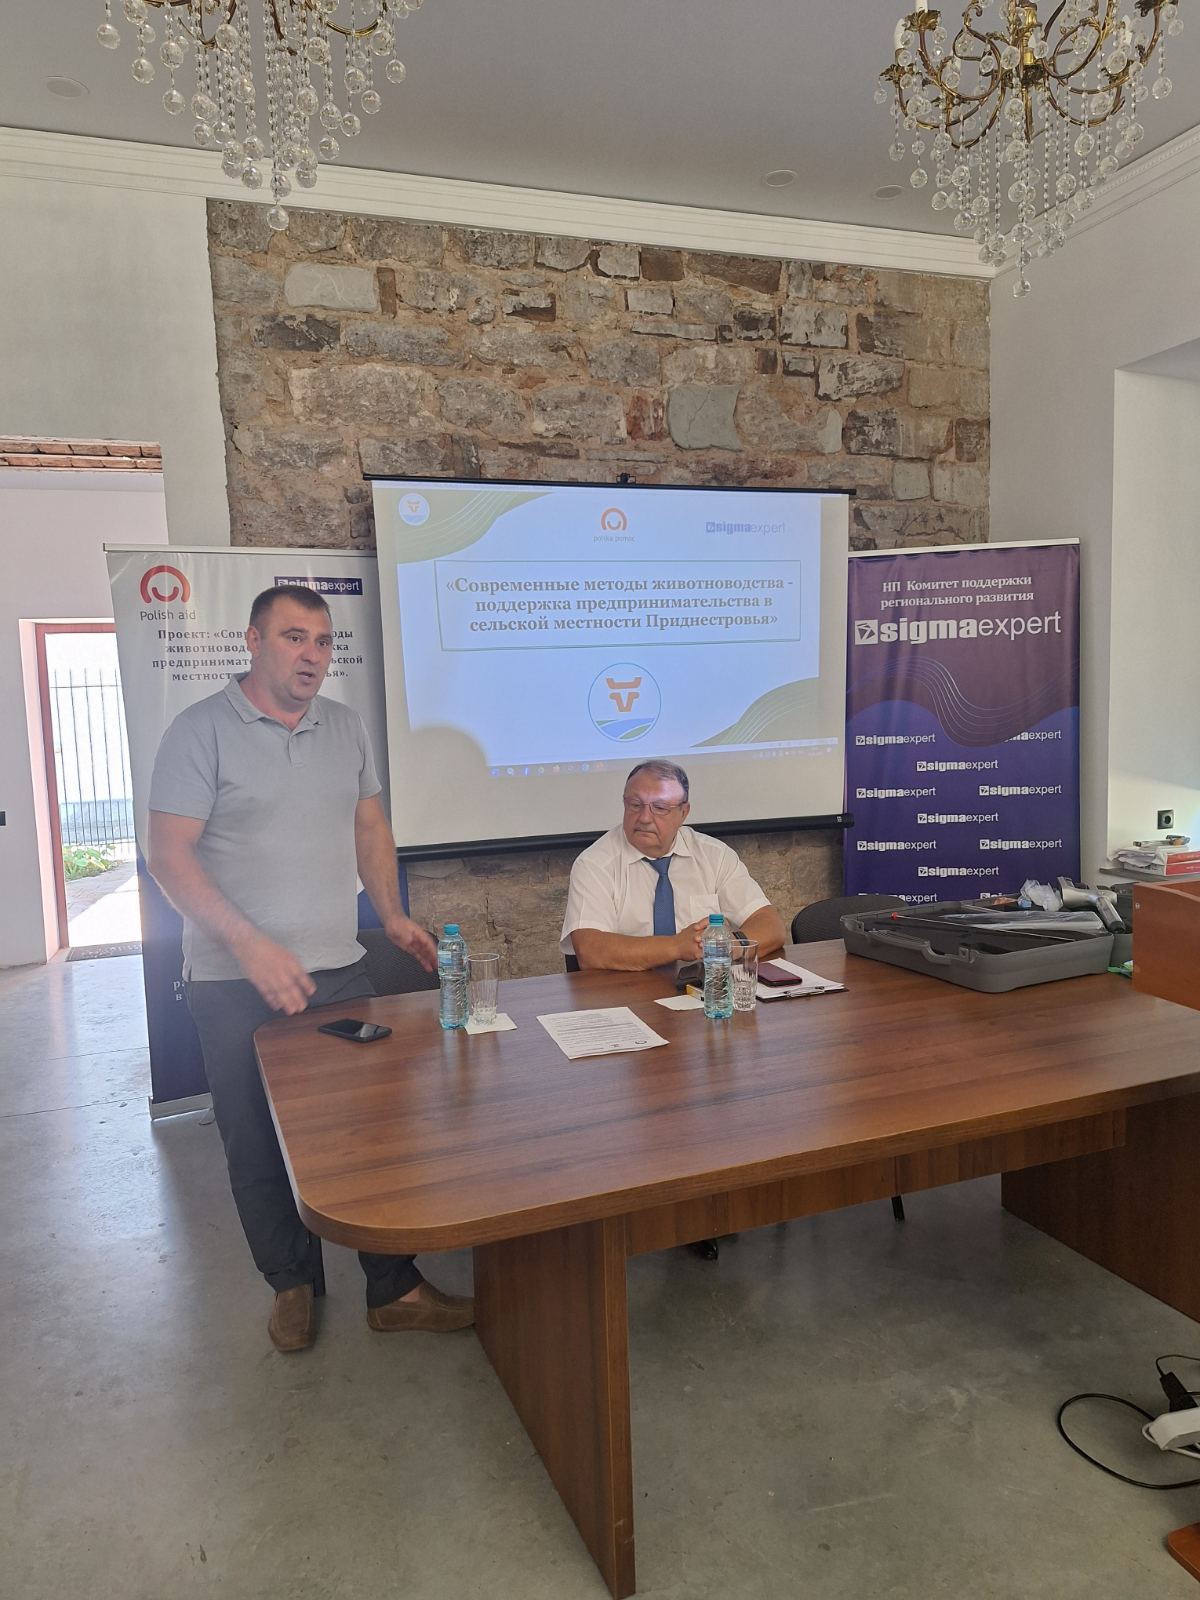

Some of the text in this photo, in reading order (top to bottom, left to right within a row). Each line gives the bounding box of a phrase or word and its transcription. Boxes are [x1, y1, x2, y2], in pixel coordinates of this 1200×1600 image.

[716, 521, 786, 536] sigmaexpert
[446, 577, 580, 595] «Современные
[584, 580, 648, 592] методы
[652, 578, 784, 591] животноводства
[882, 576, 1032, 592] НП Комитет поддержки
[475, 597, 773, 615] поддержка предпринимательства в
[880, 592, 1034, 610] регионального развития
[140, 609, 196, 622] Polish aid
[469, 614, 778, 632] сельской местности Приднестровья»
[880, 611, 1061, 645] sigmaexpert
[158, 629, 210, 641] Проект:
[866, 734, 935, 747] sigmaexpert
[927, 760, 998, 772] sigmaexpert
[866, 785, 1062, 799] sigmaexpert sigmaexpert
[927, 813, 999, 824] sigmaexpert
[867, 839, 1062, 852] sigmaexpert sigmaexpert
[928, 866, 999, 878] sigmaexpert
